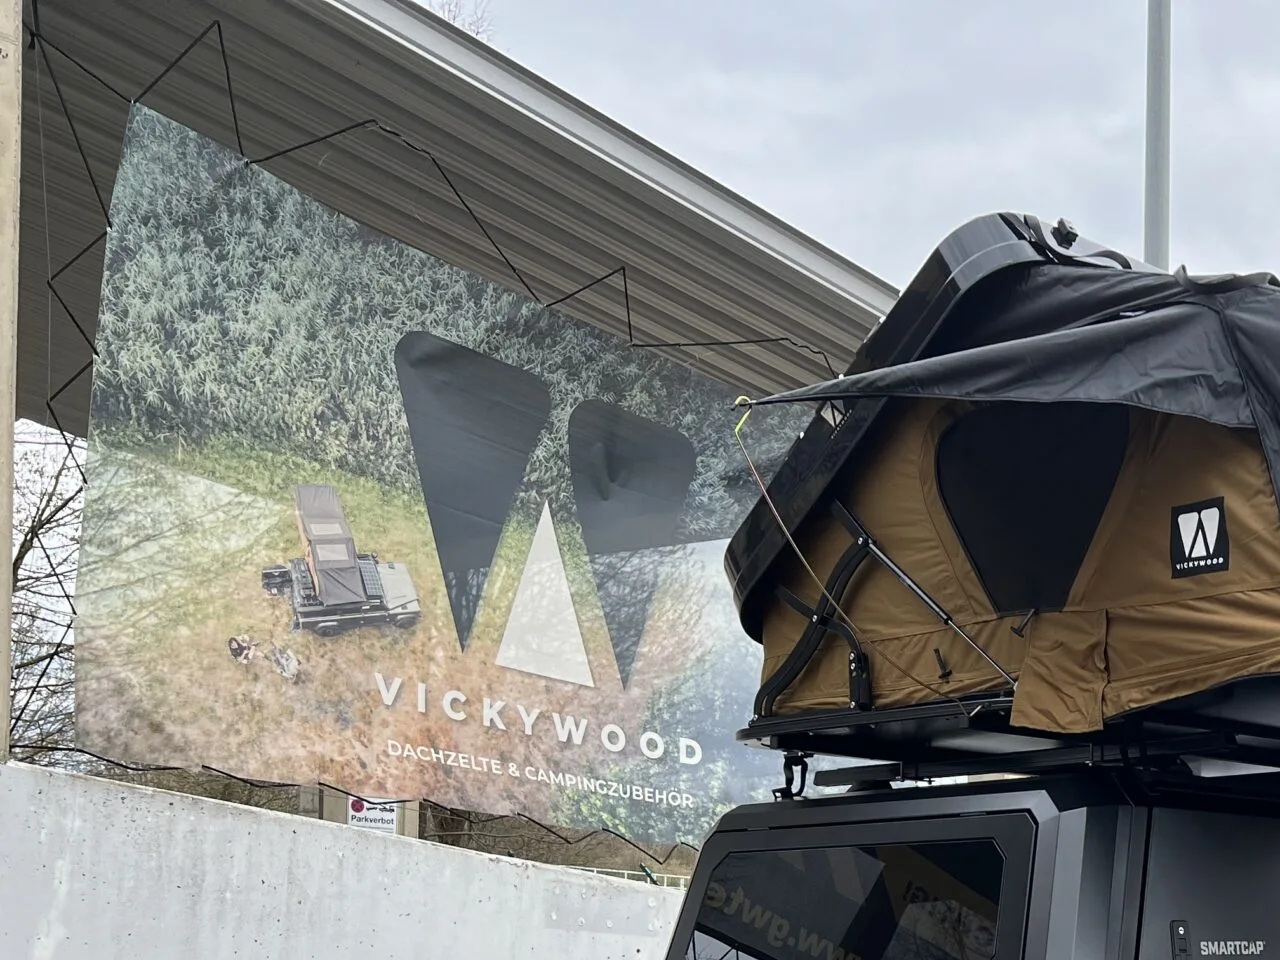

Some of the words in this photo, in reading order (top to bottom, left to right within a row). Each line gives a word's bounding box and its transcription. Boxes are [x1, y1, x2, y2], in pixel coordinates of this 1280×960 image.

[1176, 557, 1224, 570] VICKYWOOD
[374, 672, 703, 766] VICKYWOOD
[386, 739, 503, 775] DACHZELTE
[508, 762, 520, 777] &
[525, 766, 694, 809] CAMPINGZUBEHÖR
[351, 814, 395, 825] Parkverbot
[1200, 941, 1264, 956] SMARTCAP
